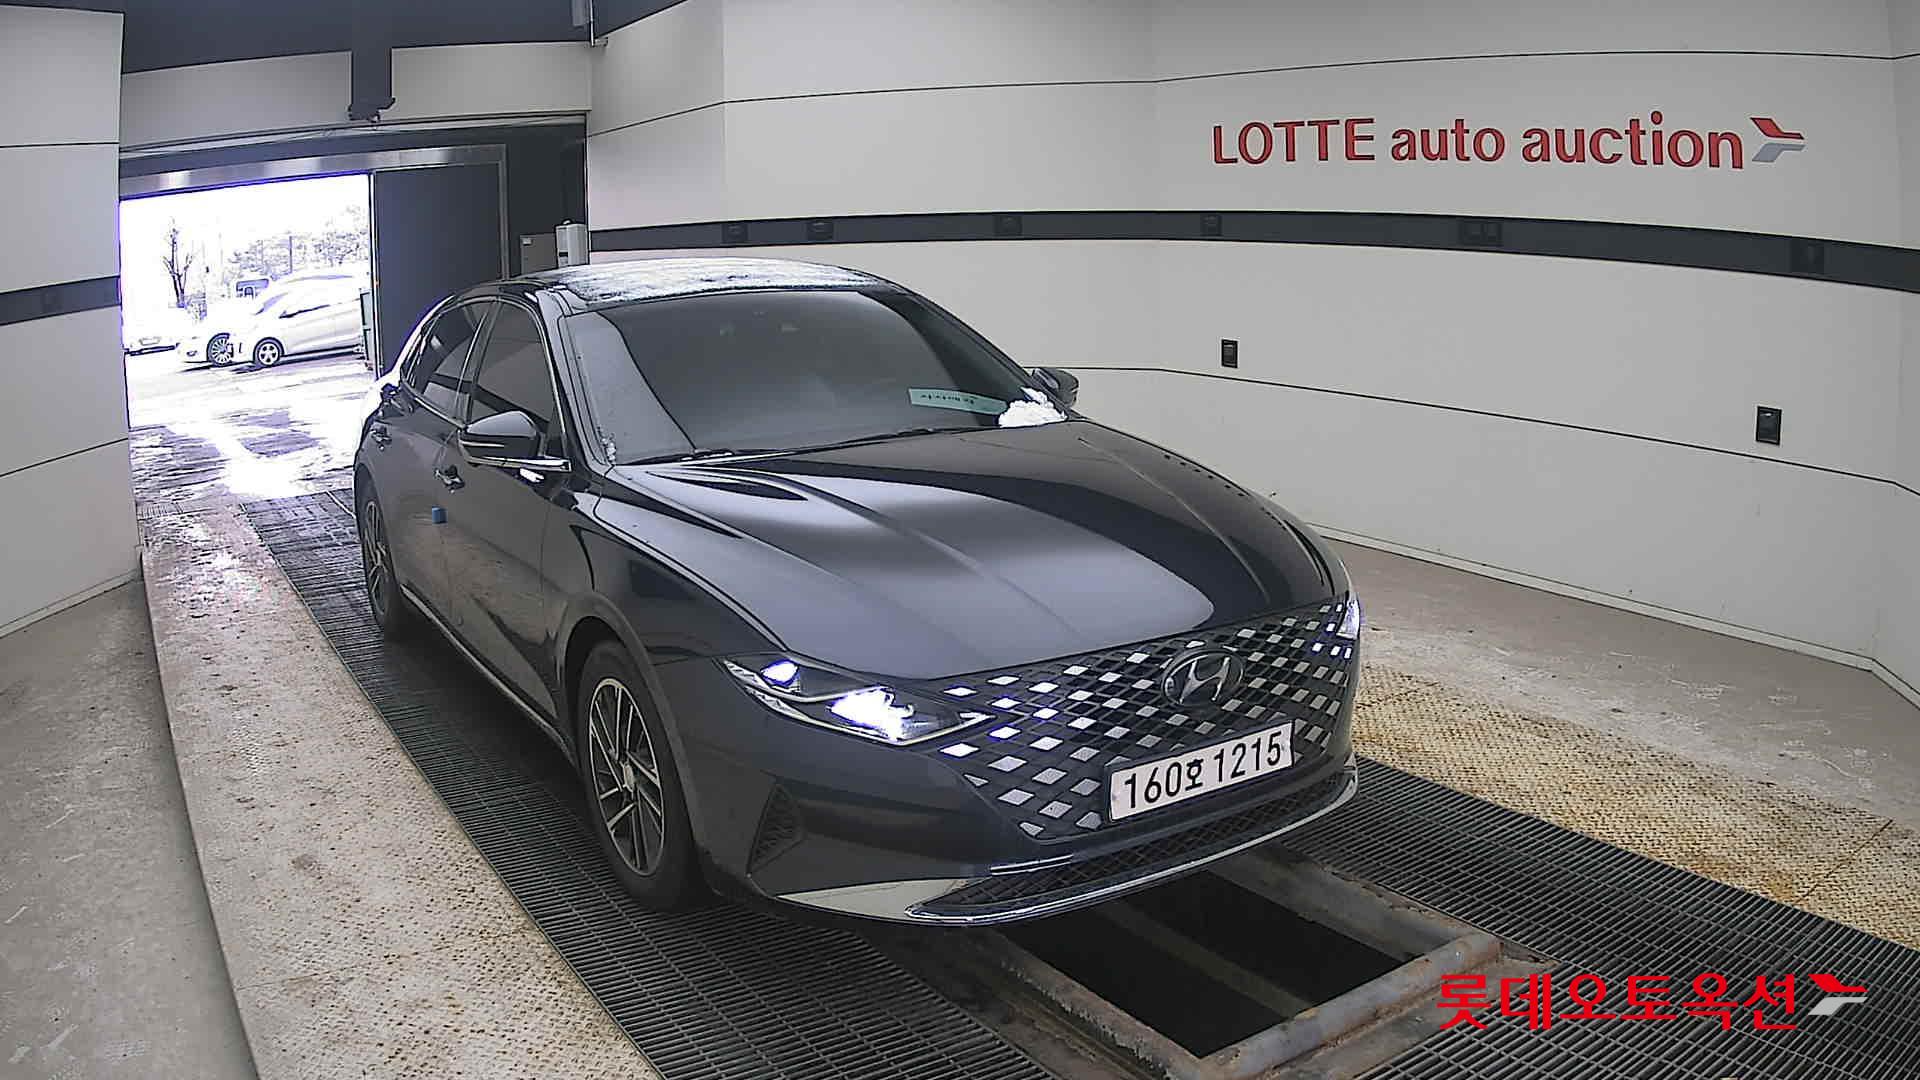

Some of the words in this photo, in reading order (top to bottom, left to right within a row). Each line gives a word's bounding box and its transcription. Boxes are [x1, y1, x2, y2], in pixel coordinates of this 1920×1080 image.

[1212, 117, 1375, 165] LOTTE
[1391, 118, 1504, 162] auto
[1521, 110, 1744, 170] auction
[1124, 758, 1204, 809] 160호
[1214, 731, 1282, 783] 1215
